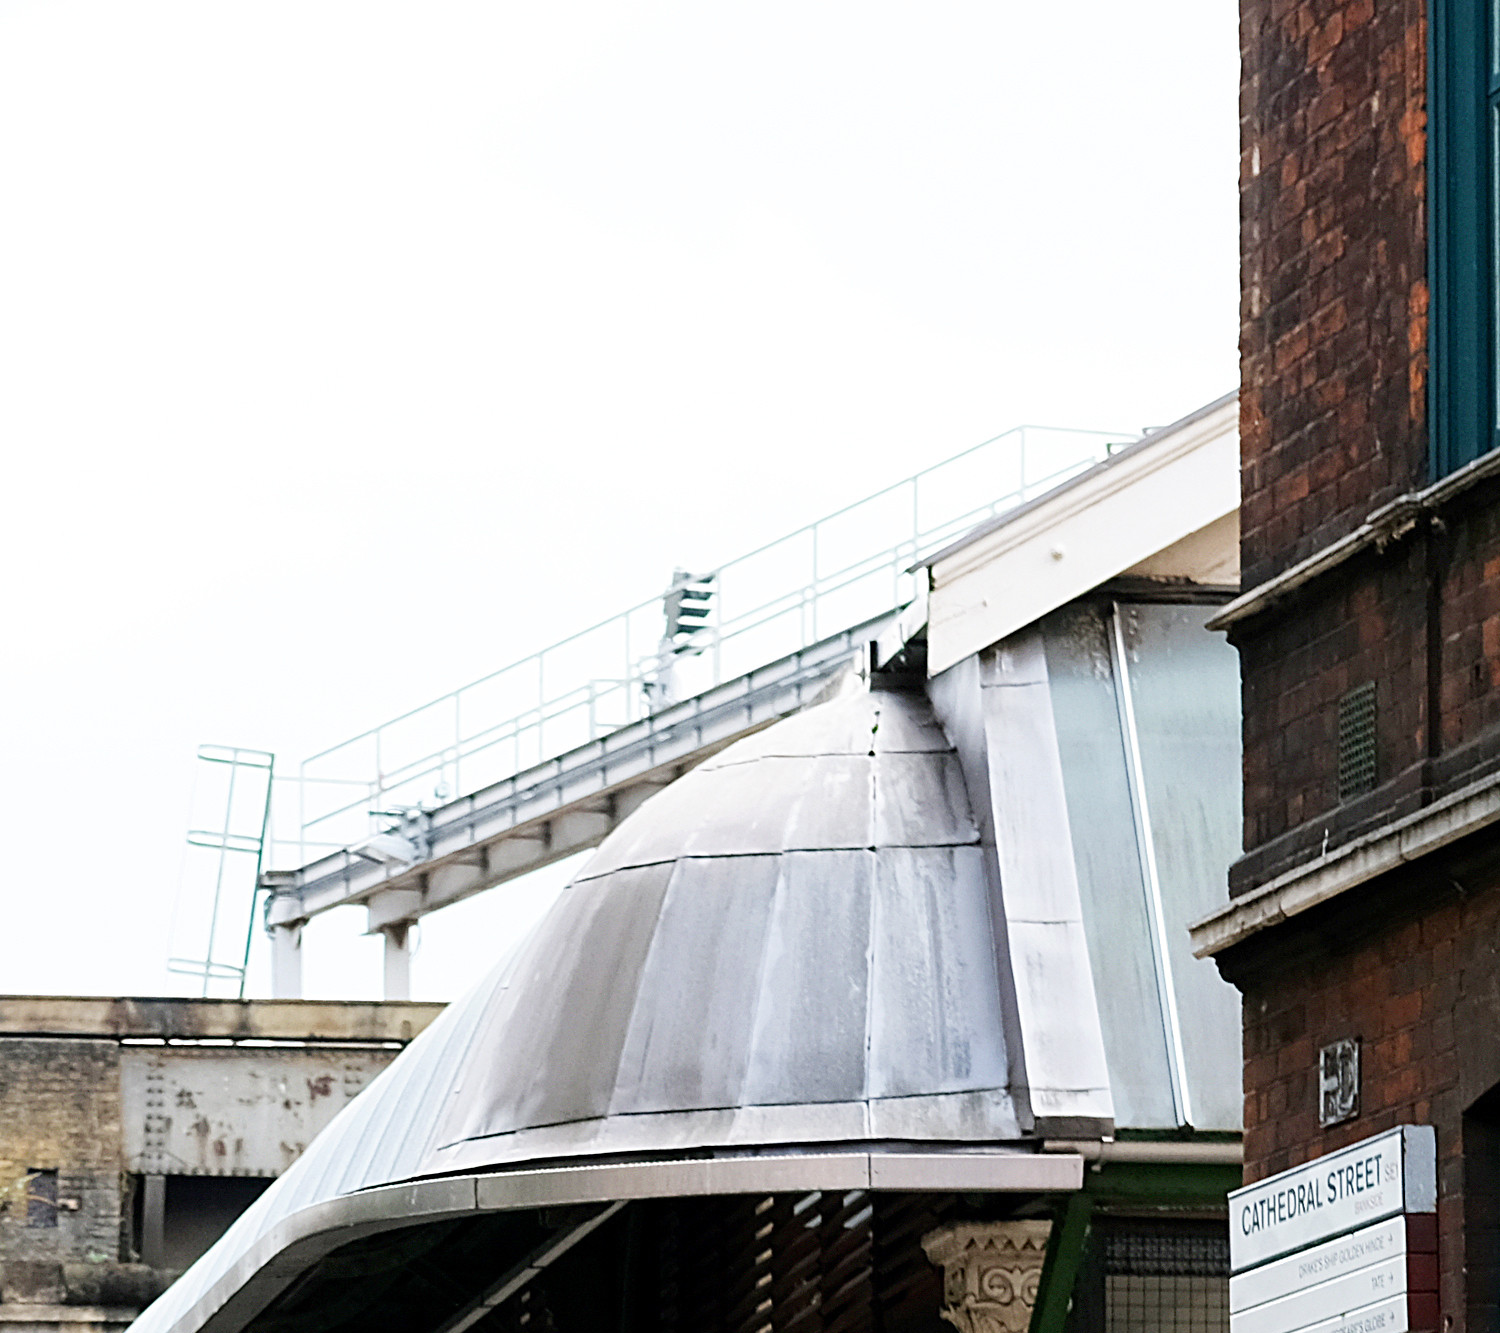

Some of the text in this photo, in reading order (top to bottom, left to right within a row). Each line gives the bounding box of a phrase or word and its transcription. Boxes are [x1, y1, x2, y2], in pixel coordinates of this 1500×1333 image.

[1241, 1178, 1323, 1236] CATHEDRAL
[1327, 1153, 1382, 1204] STREET
[1324, 1252, 1338, 1271] SHIP
[1339, 1243, 1366, 1264] GOLDEN
[1365, 1236, 1384, 1255] HINDE
[1371, 1273, 1385, 1291] TATE
[1364, 1312, 1386, 1332] GLOBE
